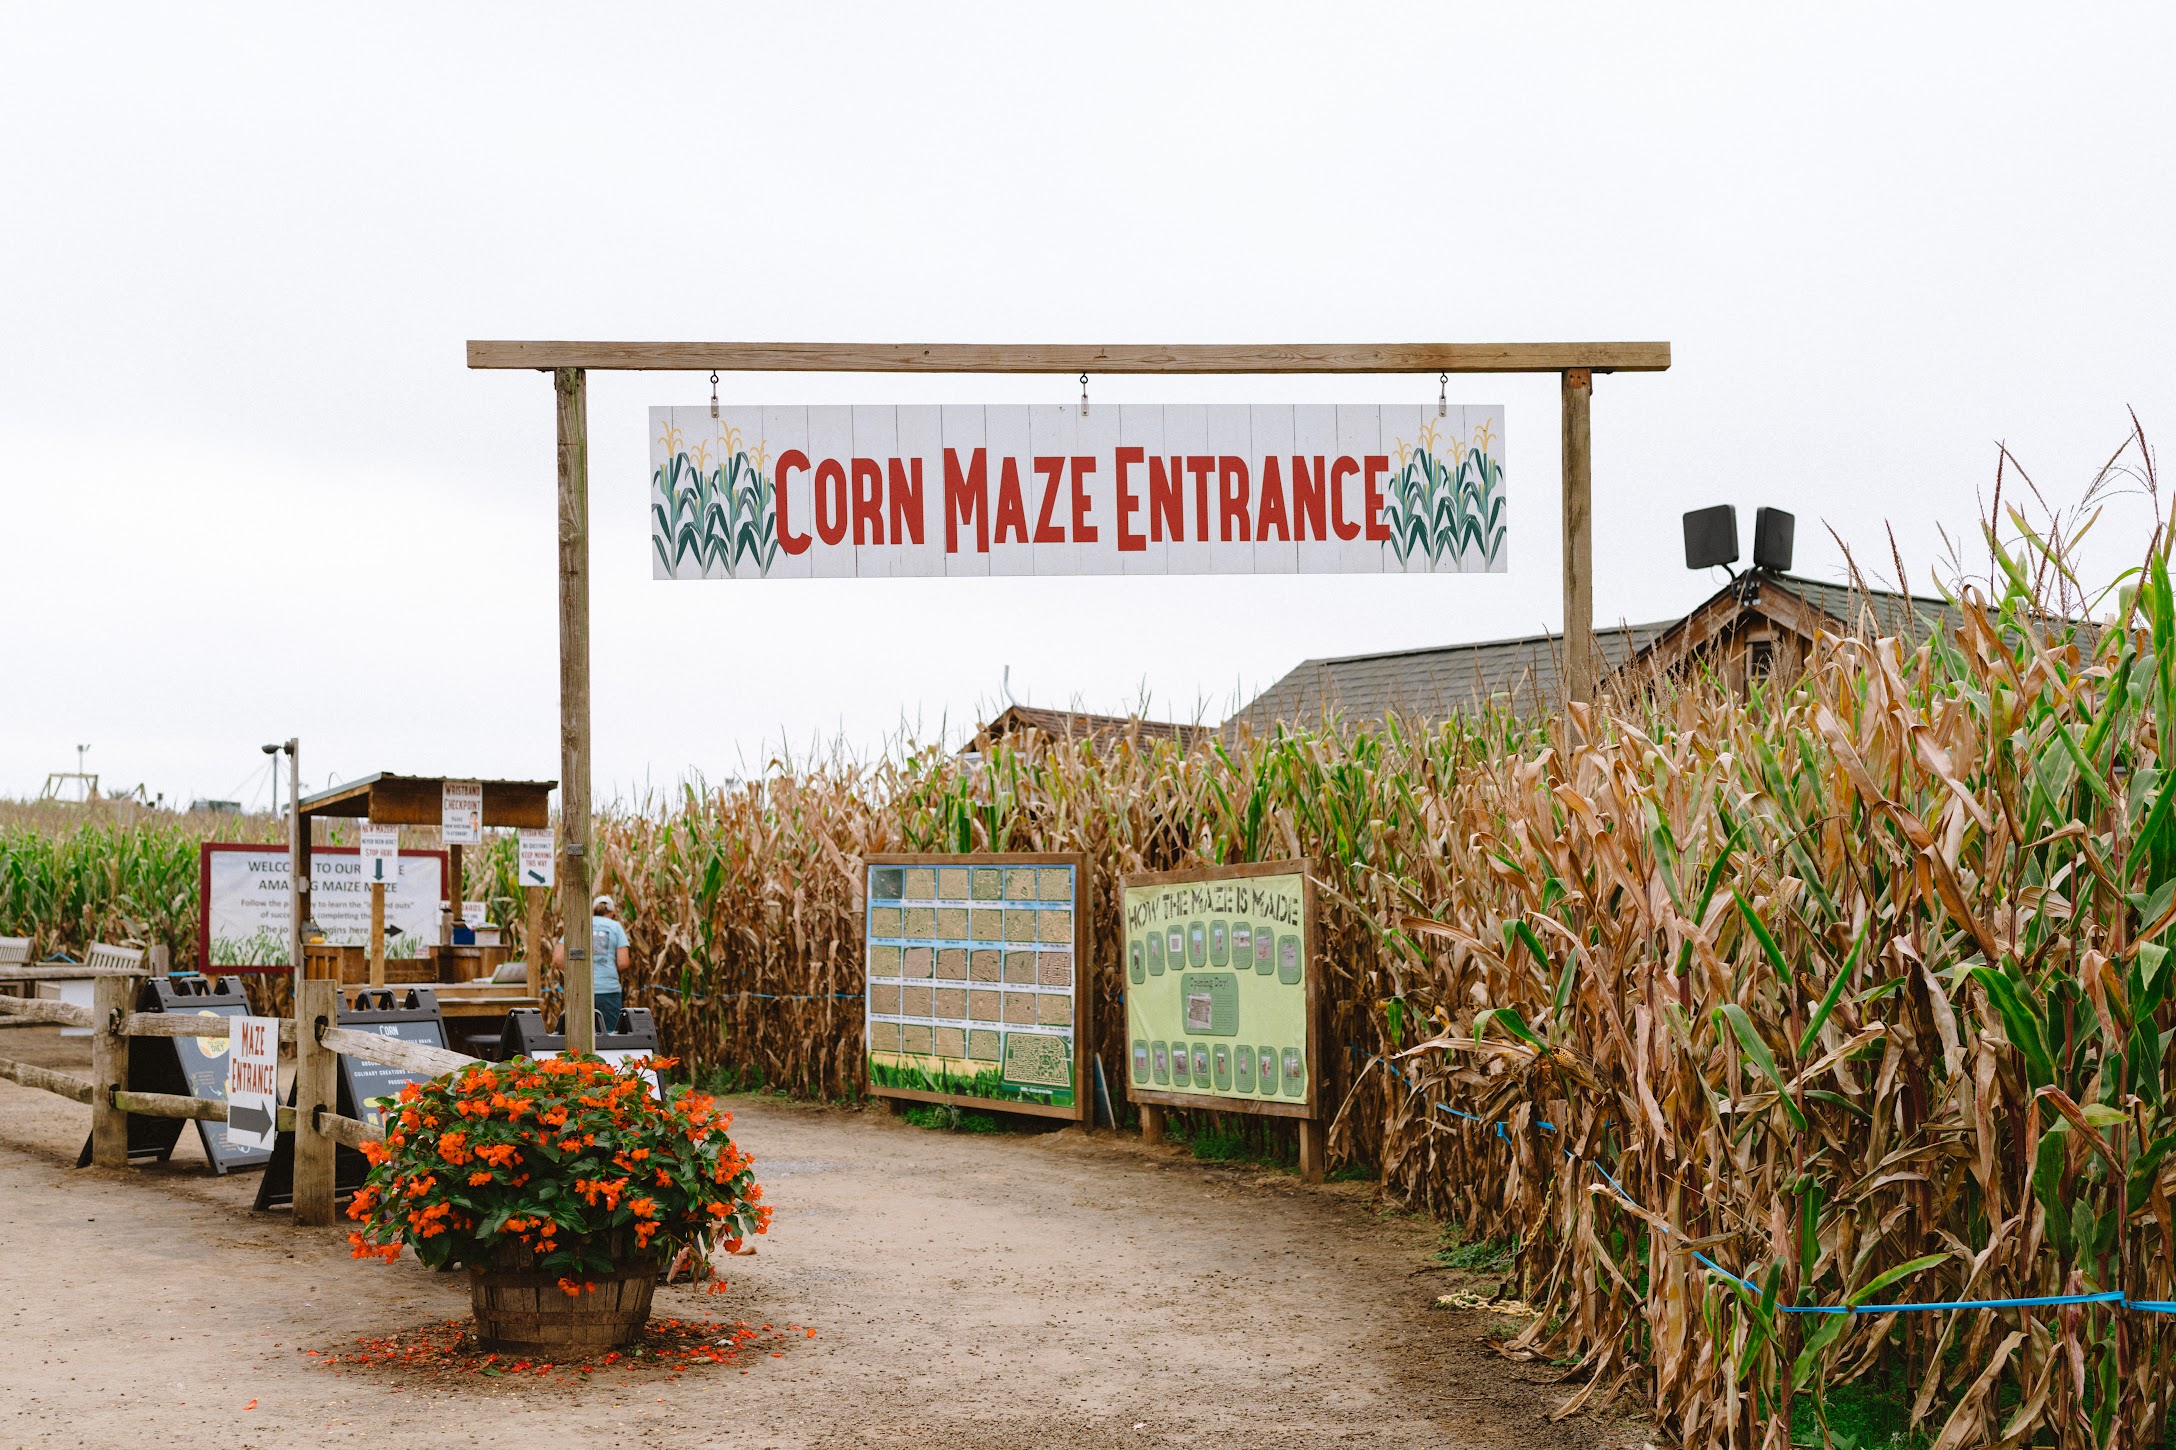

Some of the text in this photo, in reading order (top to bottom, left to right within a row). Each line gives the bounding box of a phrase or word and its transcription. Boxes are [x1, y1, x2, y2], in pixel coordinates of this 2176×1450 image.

[774, 446, 1391, 555] CORN MAZE ENTRANCE
[444, 784, 480, 796] WRISTBAND
[444, 798, 480, 811] CHECKPOINT
[365, 849, 393, 857] STOP HERE
[521, 851, 533, 859] KEEP
[316, 863, 331, 873] TO
[335, 863, 361, 874] OUR
[323, 882, 360, 892] MAIZE
[241, 899, 267, 907] Follow
[269, 899, 282, 907] the
[318, 901, 327, 909] to
[328, 901, 347, 909] learn
[349, 901, 362, 909] the
[1127, 886, 1298, 933] HOW THE MAZE IS MADE
[260, 911, 269, 919] of
[317, 913, 359, 921] completing
[379, 1025, 399, 1036] CORN
[241, 1021, 265, 1057] MAZE
[231, 1058, 274, 1095] ENTRANCE
